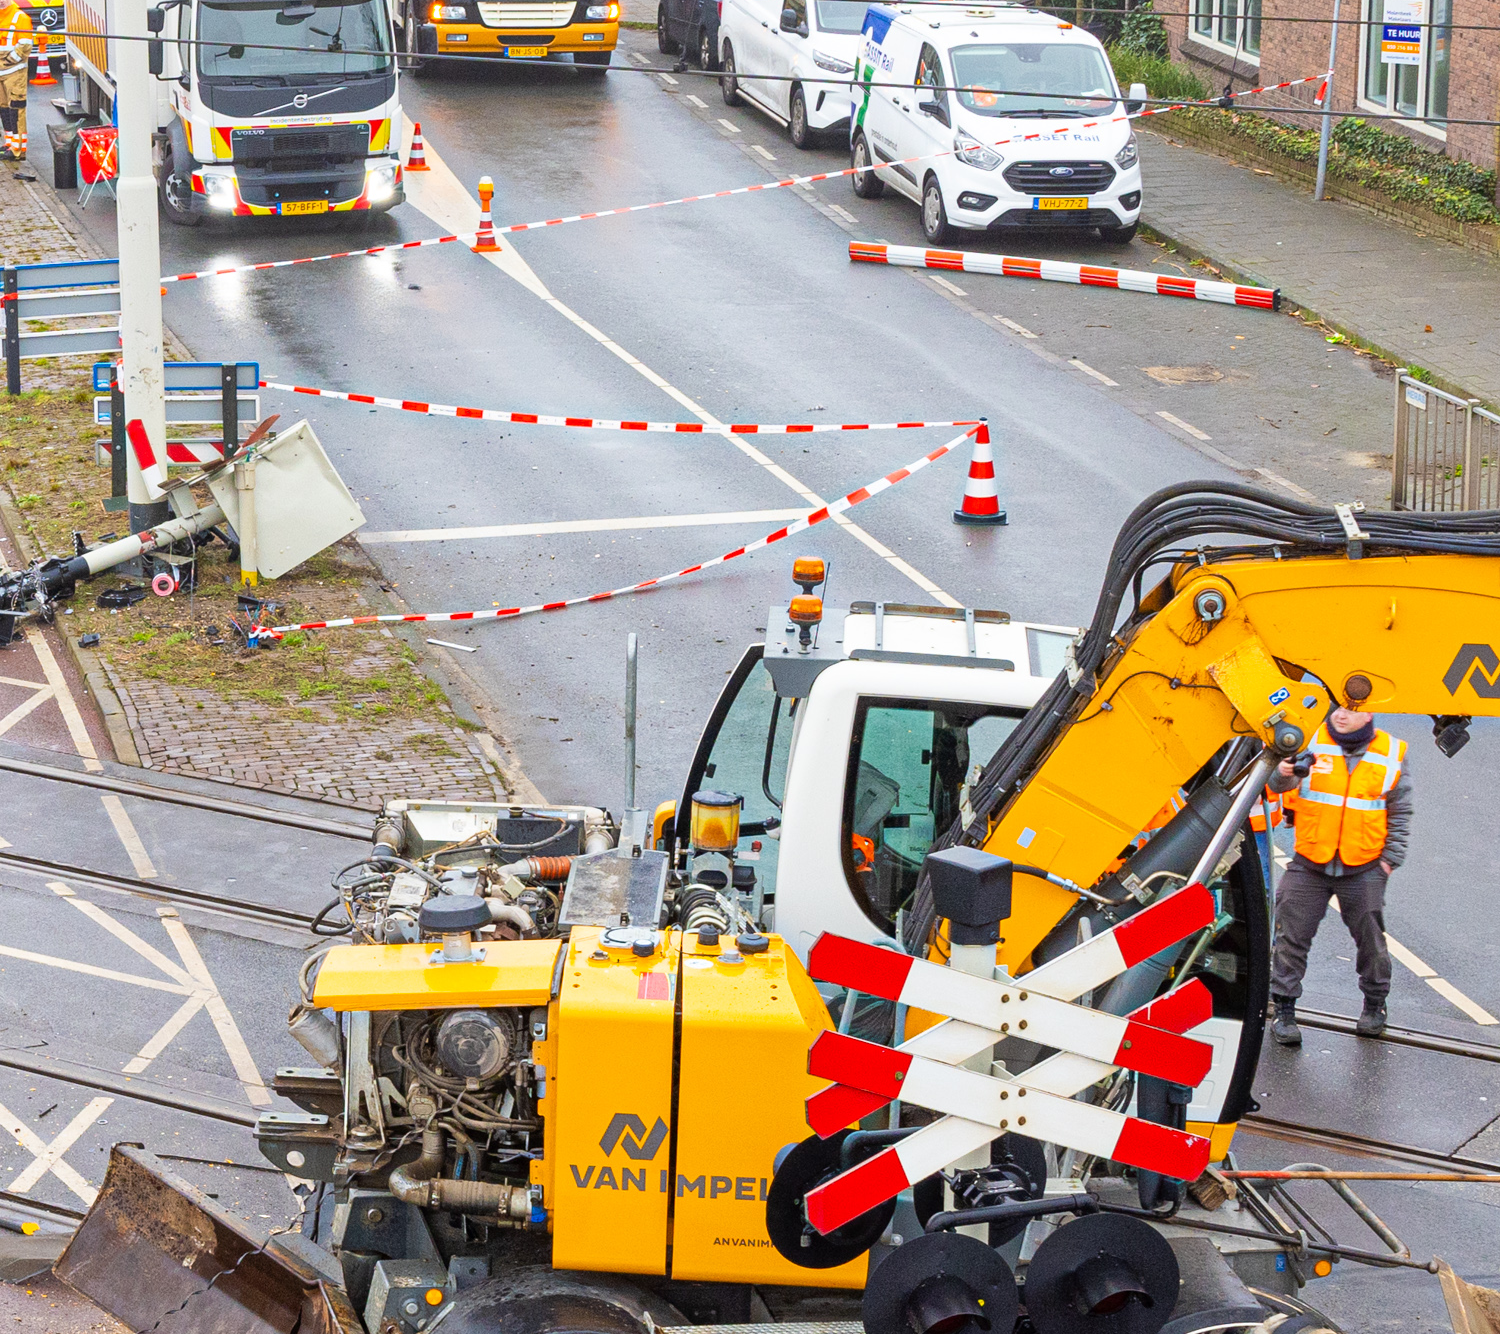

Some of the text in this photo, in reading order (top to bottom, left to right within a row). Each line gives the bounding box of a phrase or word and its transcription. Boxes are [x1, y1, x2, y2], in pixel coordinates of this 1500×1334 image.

[1387, 29, 1420, 39] TE HUUR
[509, 48, 545, 56] BN-JS-08
[270, 116, 332, 124] Incidentenbestrijding
[1073, 133, 1100, 142] Rail
[286, 202, 323, 212] 57-BFF-1
[1042, 198, 1084, 208] VHJ-77-Z
[569, 1164, 647, 1192] VAN
